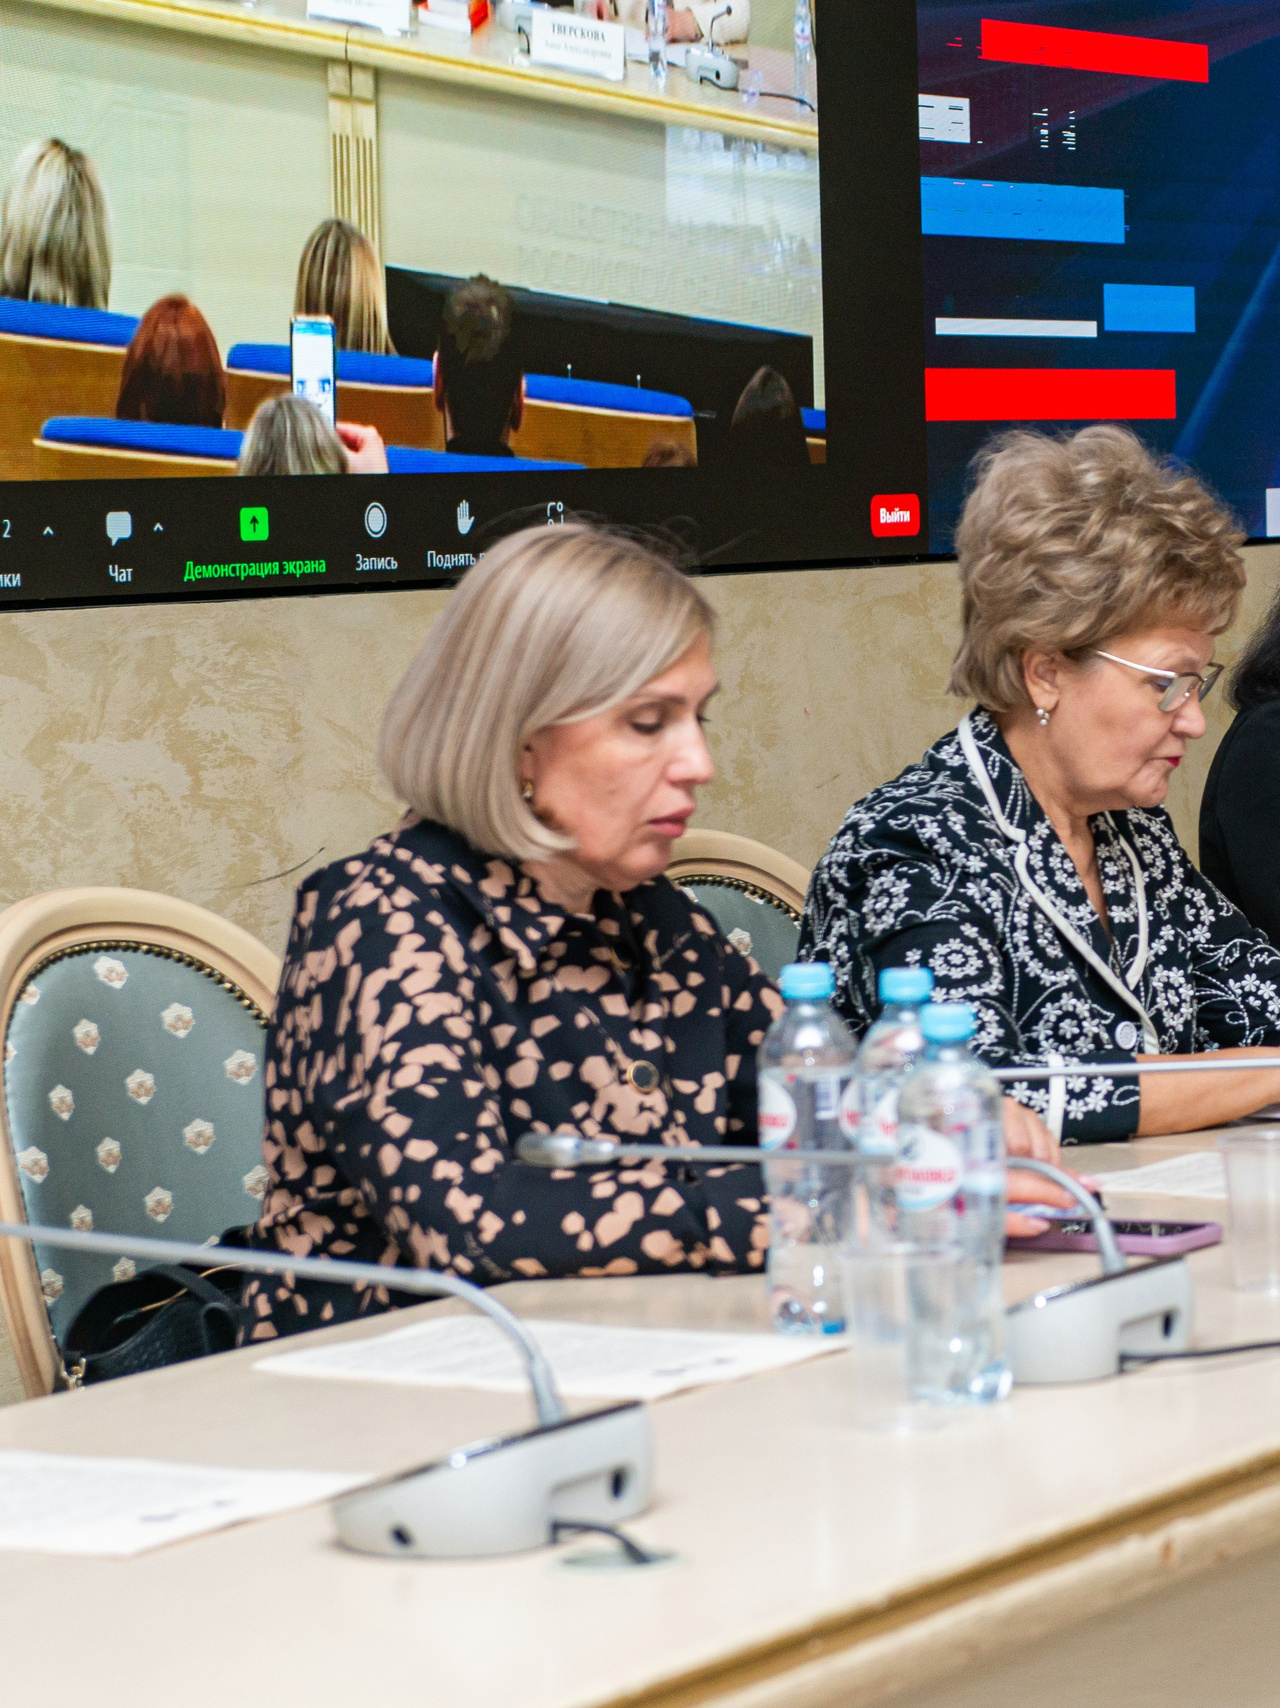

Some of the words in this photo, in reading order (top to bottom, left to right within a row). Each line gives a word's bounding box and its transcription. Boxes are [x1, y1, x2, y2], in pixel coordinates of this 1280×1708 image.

[879, 507, 911, 524] Выйти
[2, 519, 12, 539] 2
[355, 553, 399, 571] Запись
[426, 551, 477, 569] Поднять
[108, 564, 133, 582] Чат
[183, 560, 280, 583] Демонстрация
[282, 559, 327, 578] экрана
